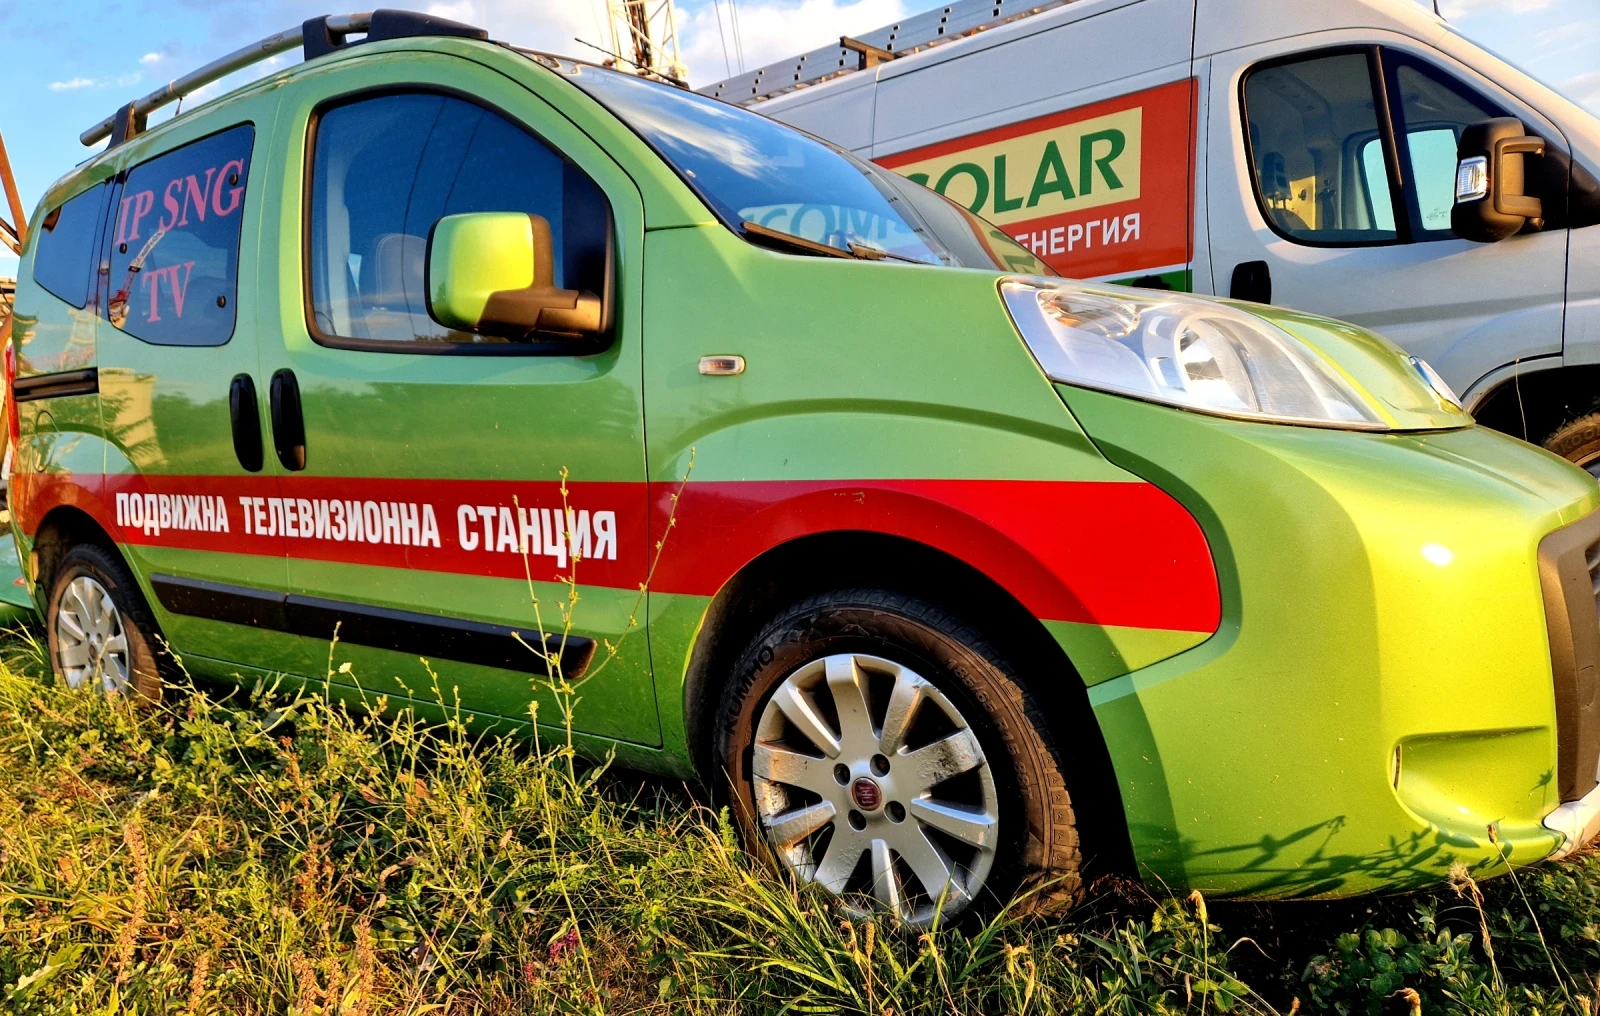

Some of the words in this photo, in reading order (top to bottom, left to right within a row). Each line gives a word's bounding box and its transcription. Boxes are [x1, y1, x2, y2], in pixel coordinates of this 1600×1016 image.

[115, 190, 155, 246] IP
[159, 158, 245, 232] SNG
[141, 261, 195, 323] TV
[115, 492, 230, 537] ПОДВИЖНА
[239, 495, 442, 549] ТЕЛЕВИЗИОННА
[457, 503, 618, 569] СТАНЦИЯ
[723, 645, 775, 736] KUMHO
